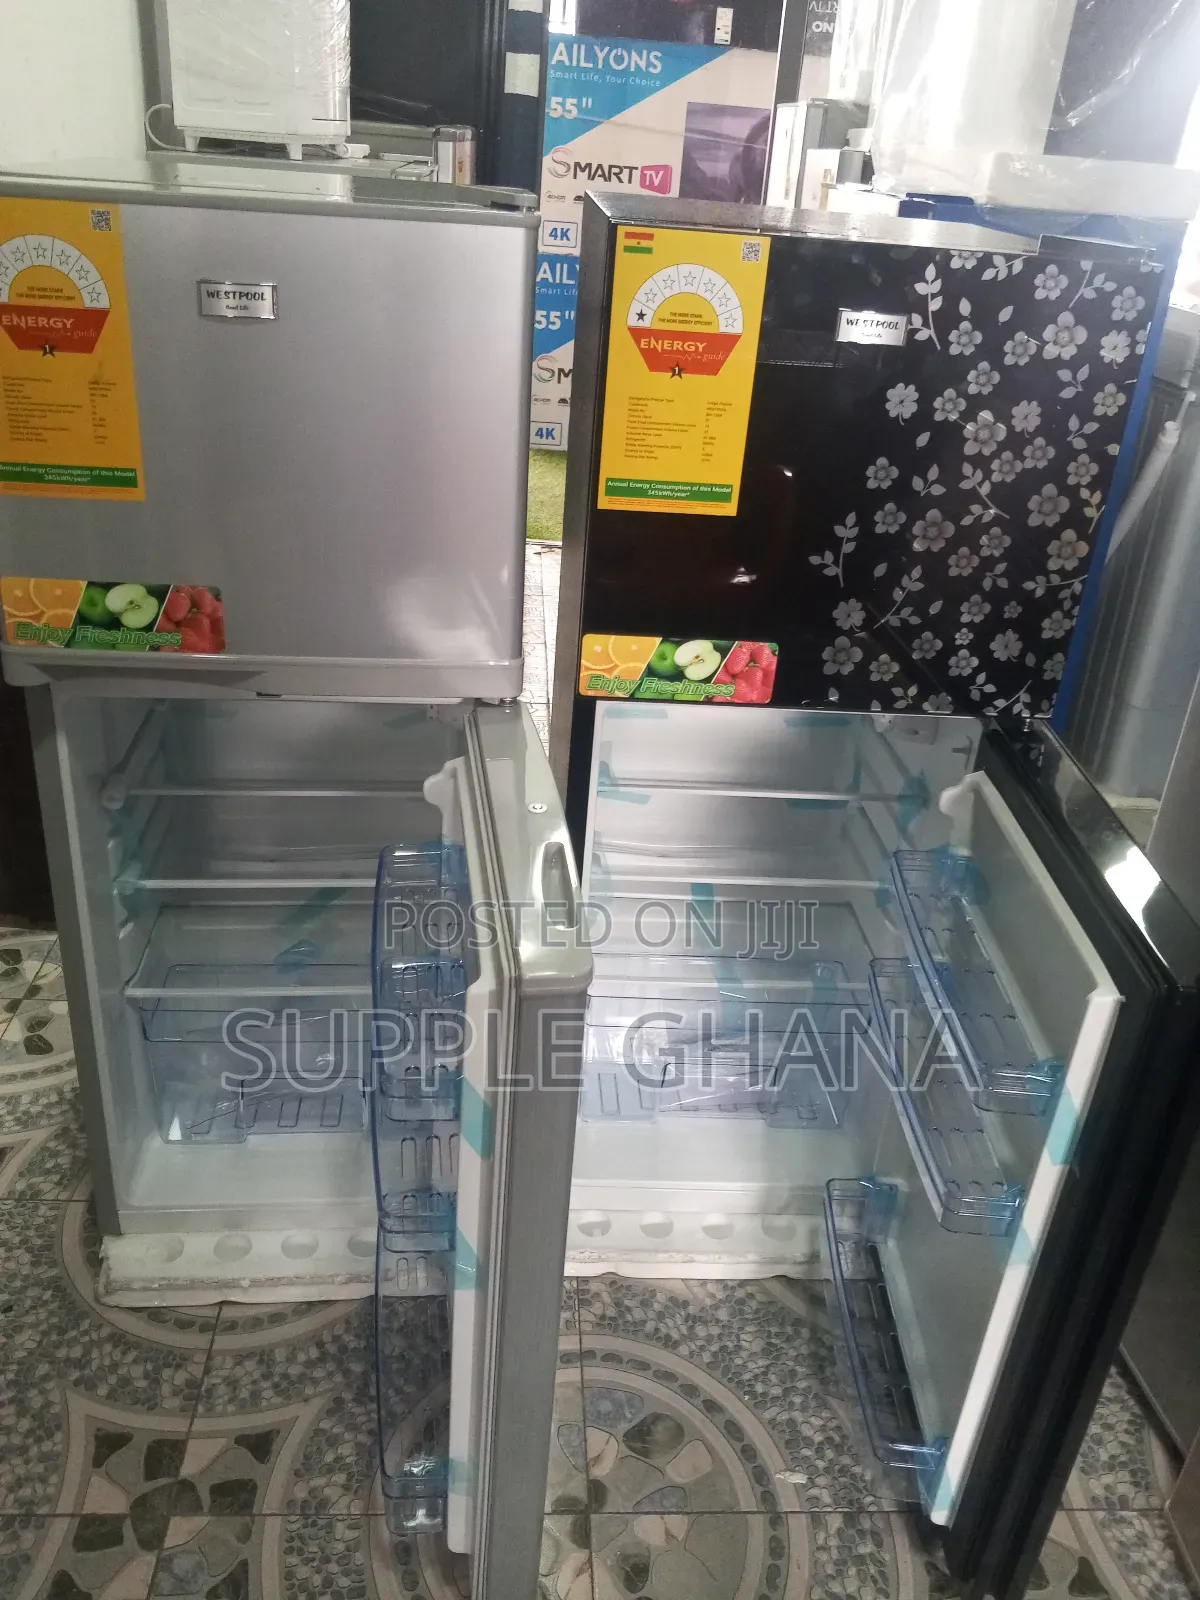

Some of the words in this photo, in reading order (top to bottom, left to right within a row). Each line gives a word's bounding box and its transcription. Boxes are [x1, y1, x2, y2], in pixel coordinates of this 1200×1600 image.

[551, 42, 662, 74] AILYONS
[550, 70, 578, 80] Smart
[581, 72, 602, 82] Life,
[605, 75, 626, 84] Your
[629, 76, 661, 87] Choice
[547, 147, 639, 184] SMART
[643, 170, 664, 187] TV
[549, 227, 571, 241] 4K
[536, 261, 579, 285] AIL
[206, 290, 267, 301] WESTPOOL
[536, 287, 560, 295] Smart
[564, 288, 578, 296] Lif
[2, 312, 75, 330] ENERGY
[846, 317, 900, 330] WESTPOOL
[640, 336, 708, 353] ENERGY
[702, 351, 726, 362] guide
[535, 428, 556, 440] 4K
[629, 482, 650, 490] Energy
[651, 483, 691, 491] Consumption
[15, 622, 72, 644] Enjoy
[76, 625, 182, 646] Freshness
[587, 674, 639, 695] Enjoy
[640, 677, 736, 697] Freshness
